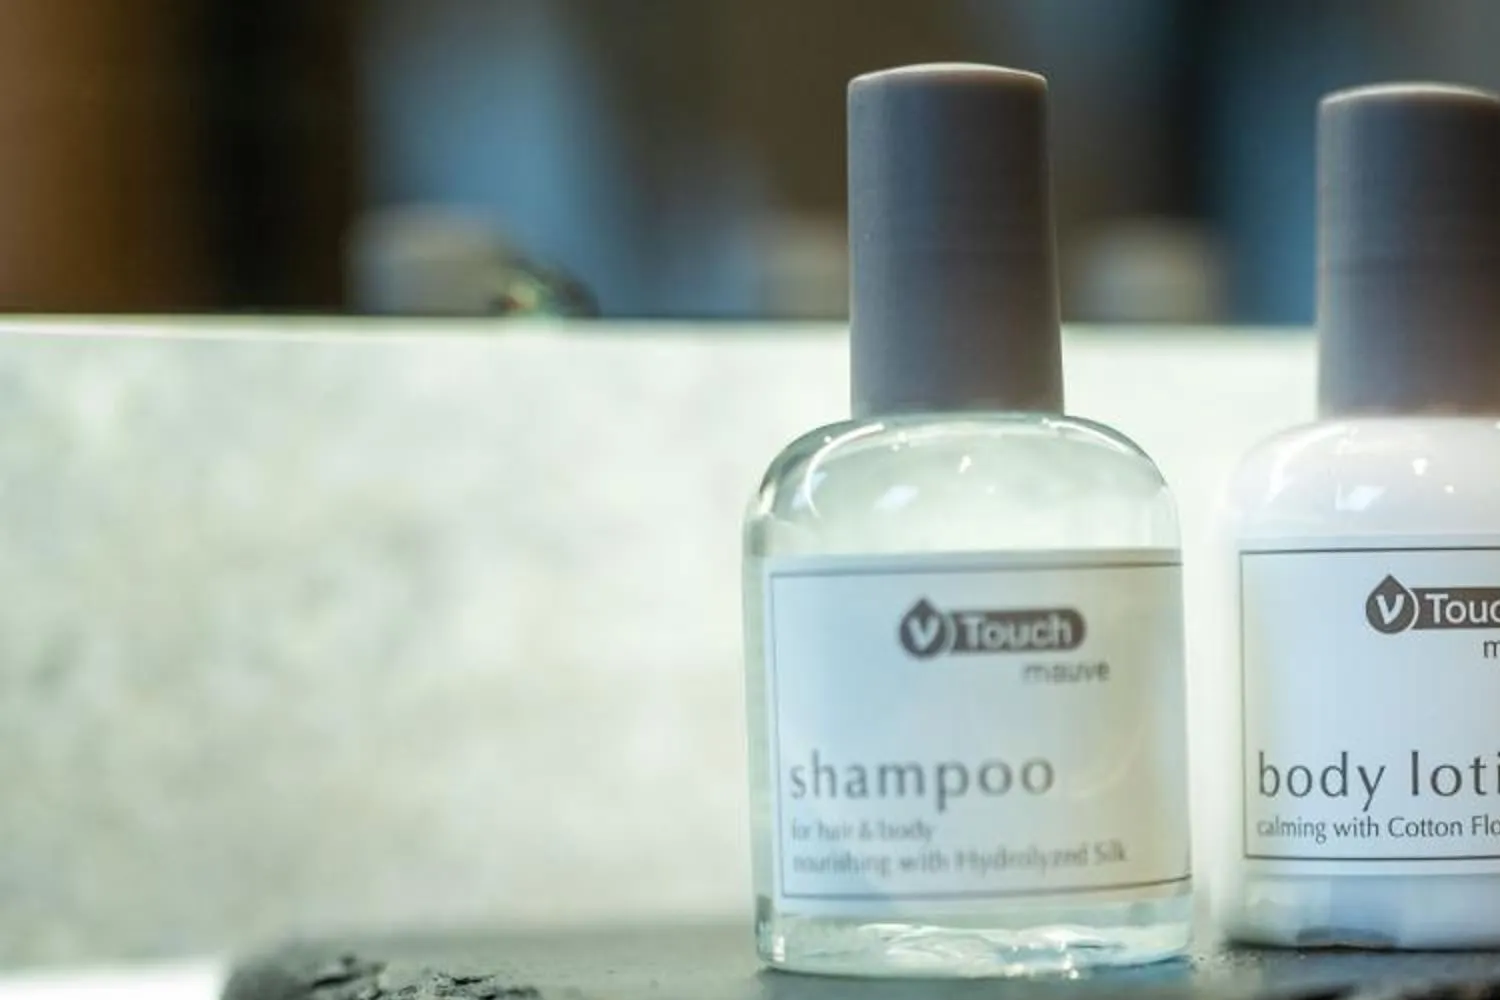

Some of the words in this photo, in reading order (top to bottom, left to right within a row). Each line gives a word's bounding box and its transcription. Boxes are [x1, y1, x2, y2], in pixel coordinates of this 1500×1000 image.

[1376, 594, 1405, 625] V
[908, 616, 940, 648] V
[959, 613, 1073, 649] Touch
[1022, 660, 1112, 684] mauve
[788, 748, 1055, 814] shampoo
[1258, 750, 1387, 813] body
[1256, 815, 1328, 845] calming
[1333, 815, 1381, 839] with
[1387, 815, 1464, 839] Cotton
[899, 848, 952, 875] with
